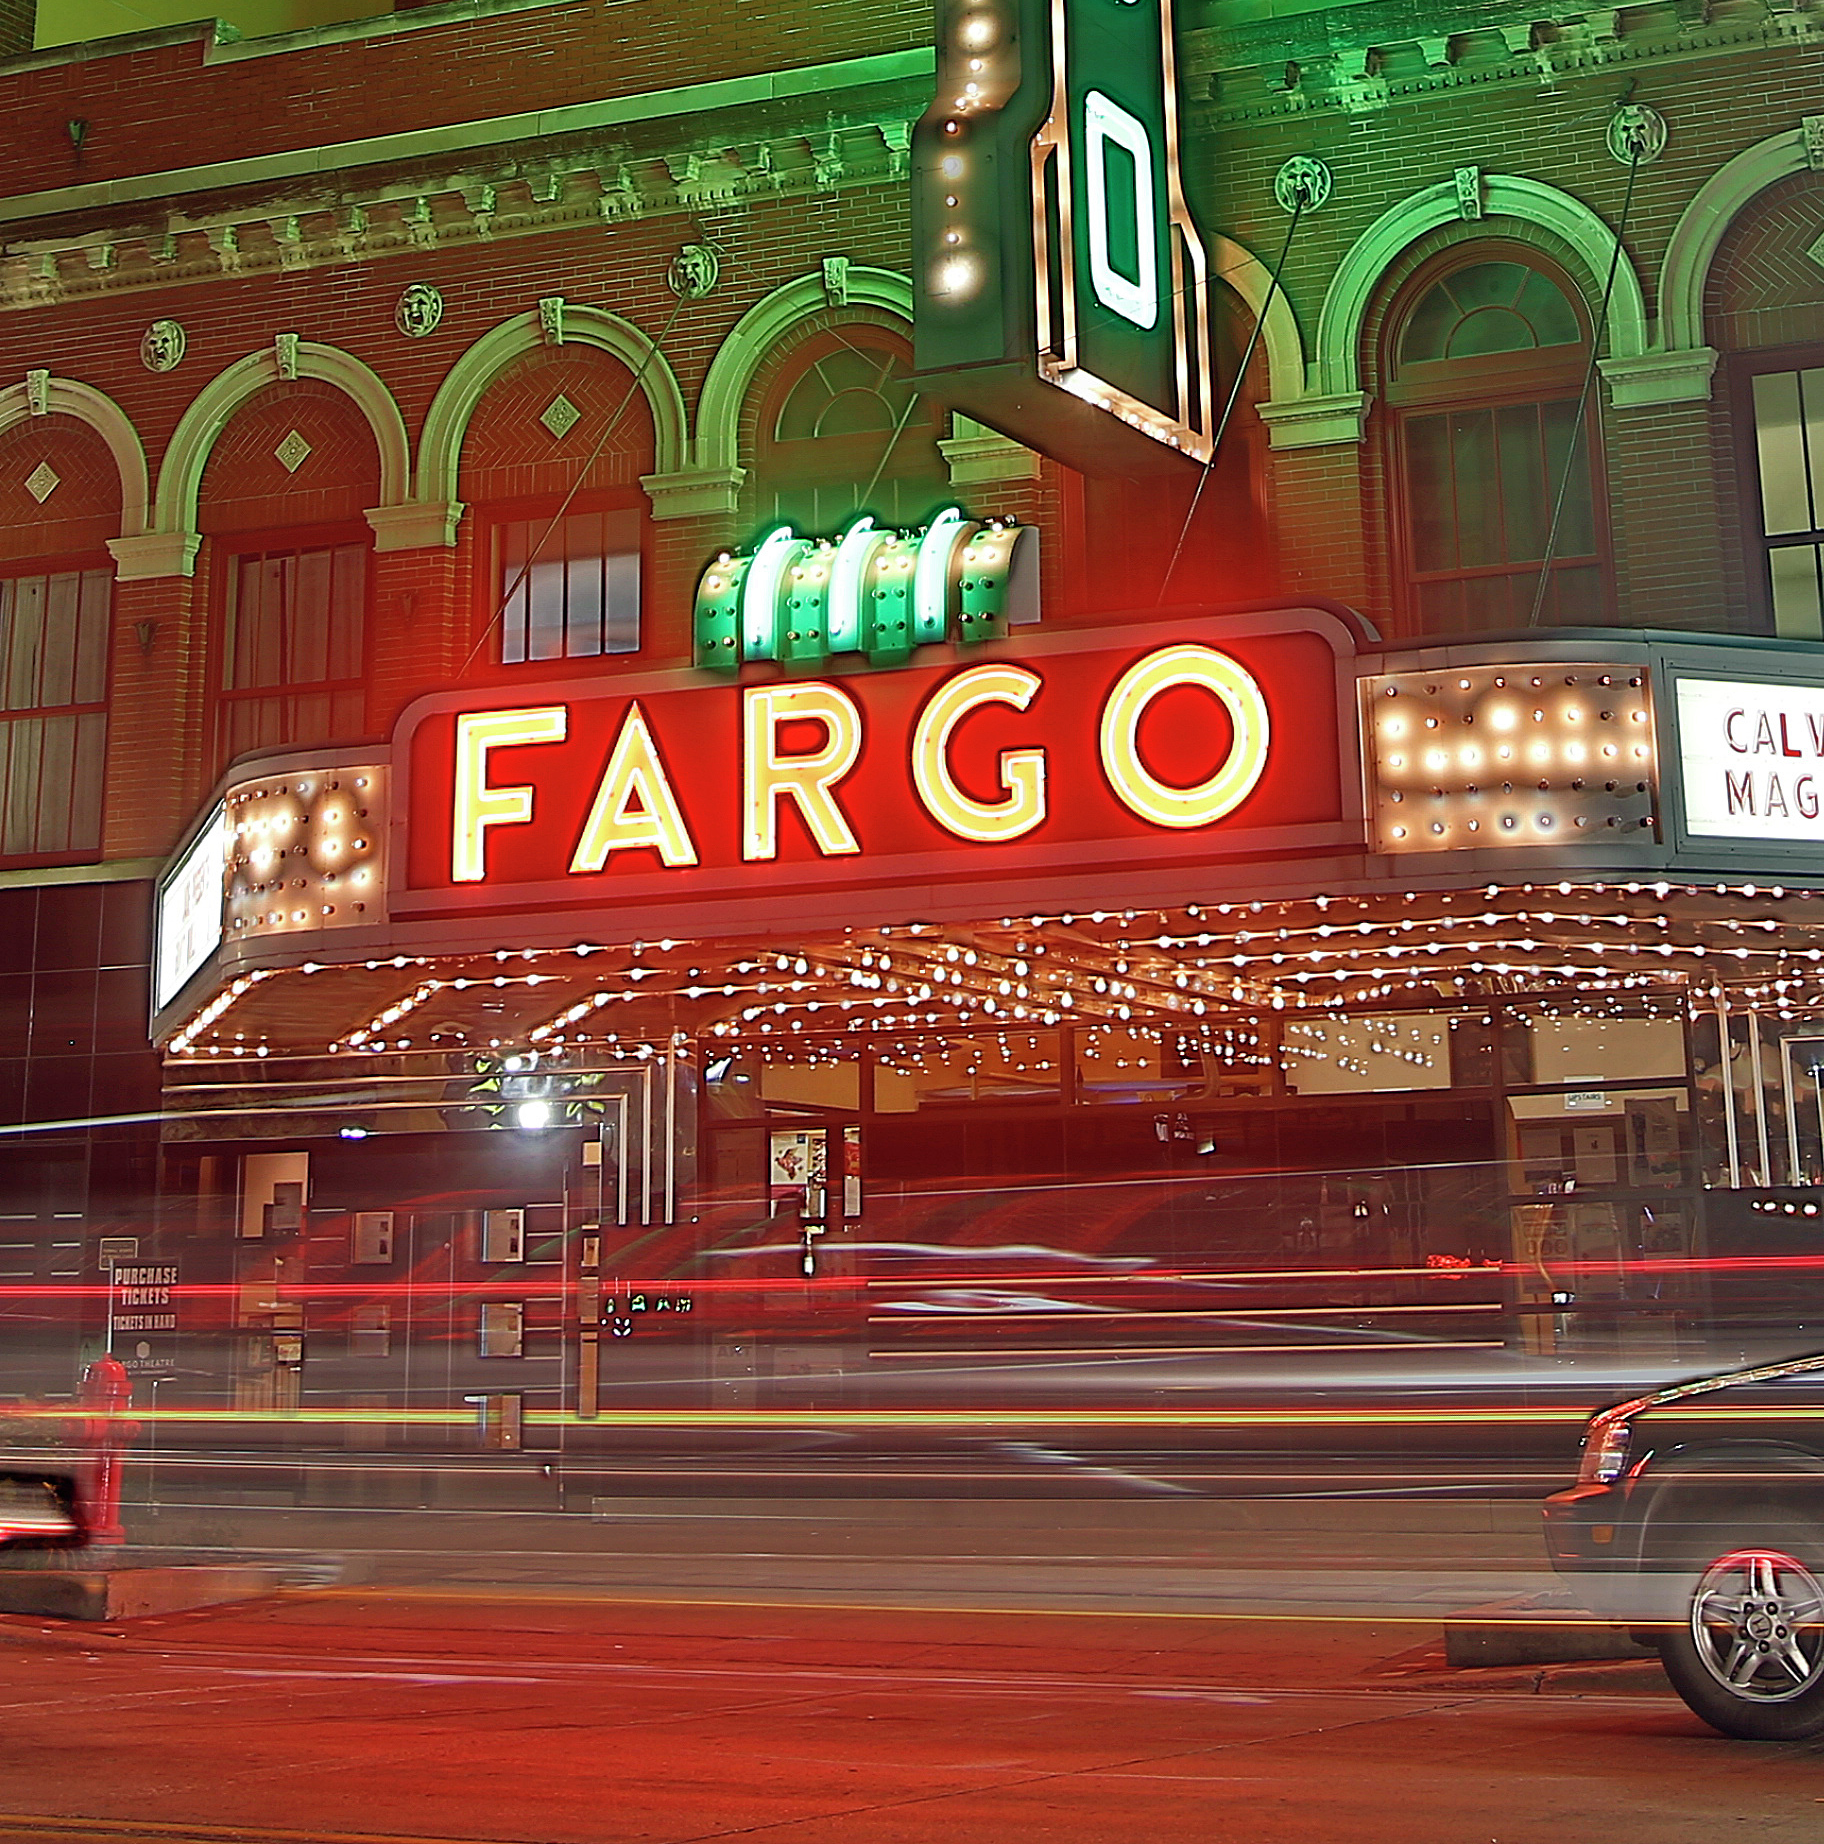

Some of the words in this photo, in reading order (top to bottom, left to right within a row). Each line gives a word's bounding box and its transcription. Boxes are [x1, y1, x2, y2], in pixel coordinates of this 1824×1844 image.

[450, 642, 1270, 884] FARGO
[114, 1266, 178, 1285] PURCHASE
[121, 1287, 170, 1305] TICKETS
[113, 1315, 144, 1330] TICKETS
[140, 1358, 175, 1368] THEATRE
